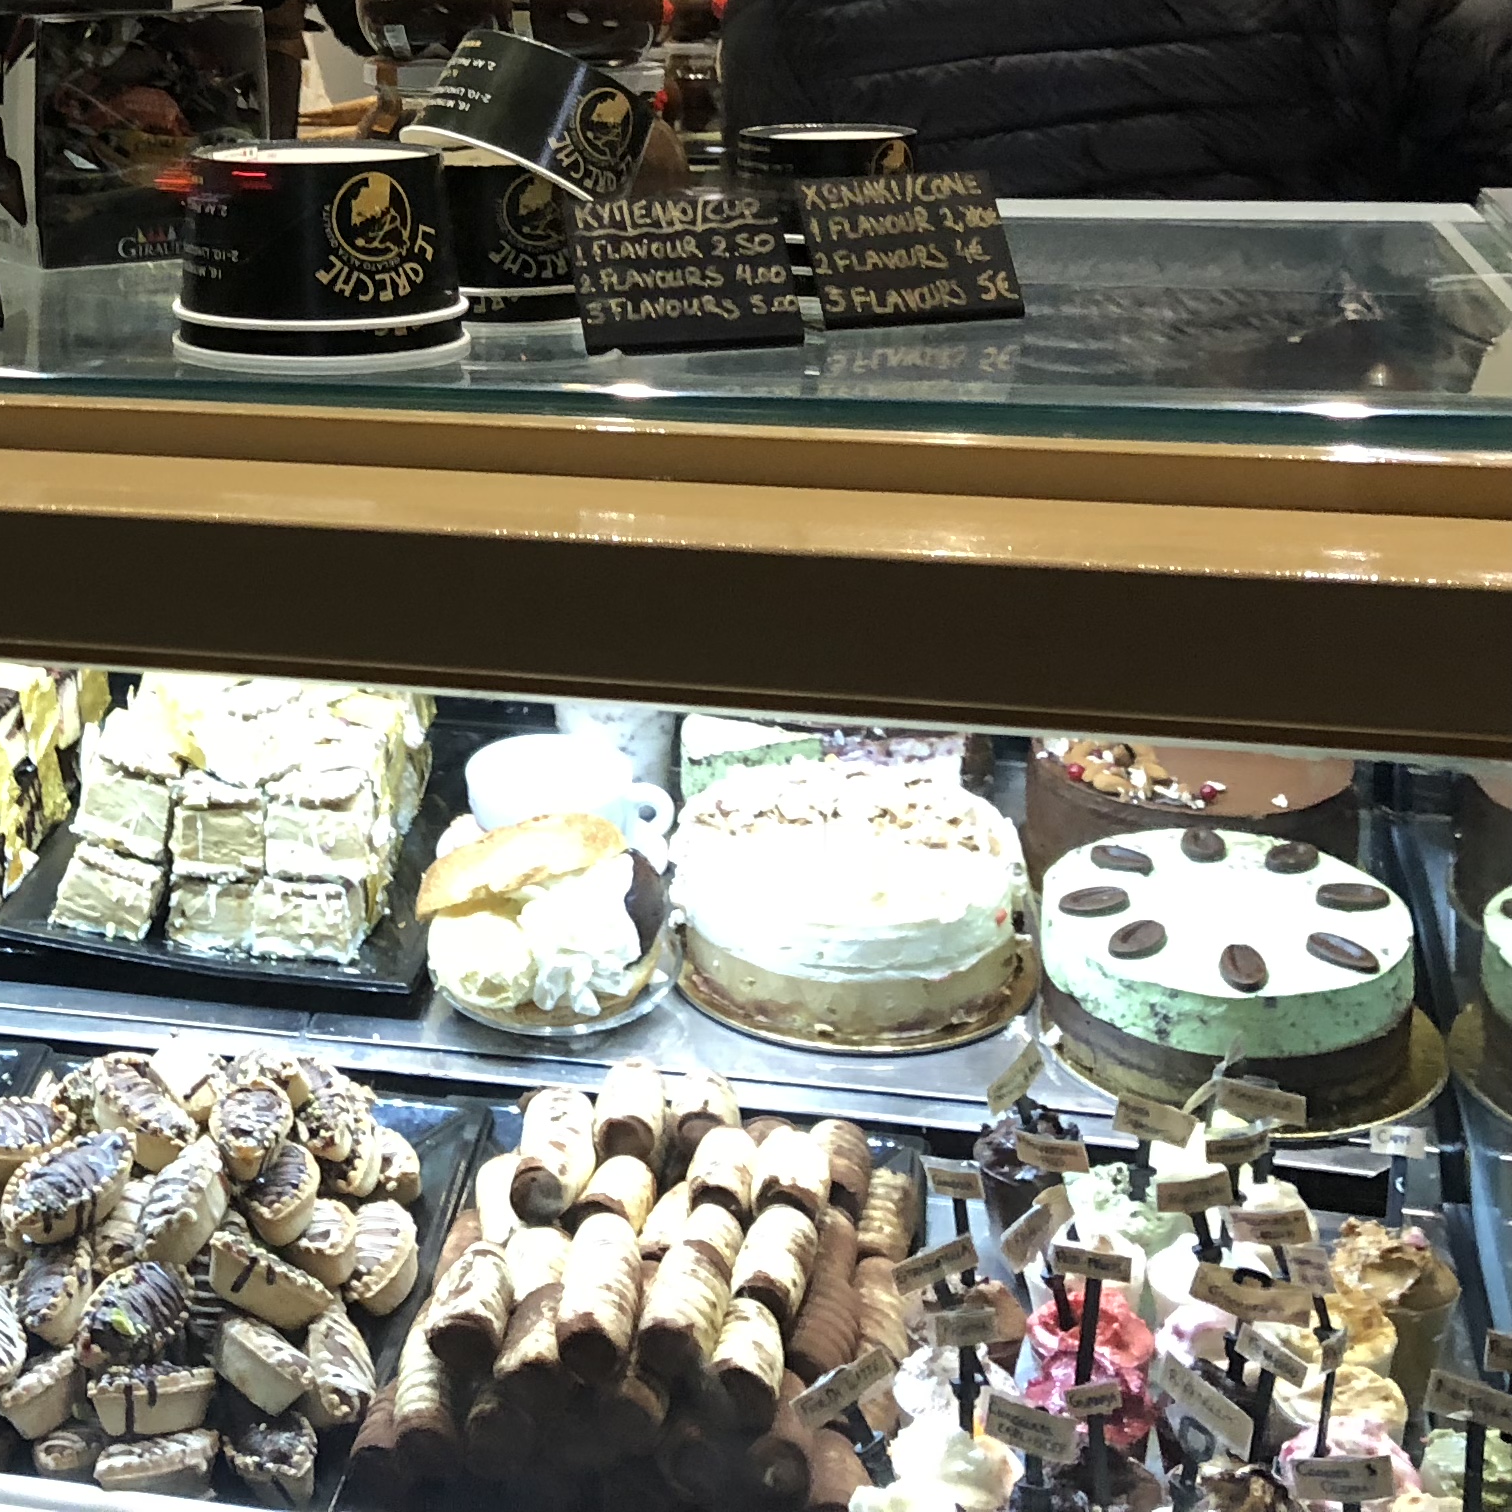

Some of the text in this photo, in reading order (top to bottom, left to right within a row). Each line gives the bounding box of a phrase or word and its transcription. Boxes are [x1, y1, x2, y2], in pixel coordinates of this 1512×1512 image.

[829, 206, 934, 242] FLAVOUR
[488, 239, 569, 279] RECHE
[592, 235, 704, 262] FLAVOUR
[815, 254, 833, 276] 2
[837, 243, 950, 273] FLAVOURS
[314, 254, 424, 303] GRECHE
[599, 266, 725, 292] FLAVOURS
[851, 279, 968, 314] FLAVOURS
[976, 269, 1020, 301] 5€
[609, 294, 741, 322] FLAVOURS
